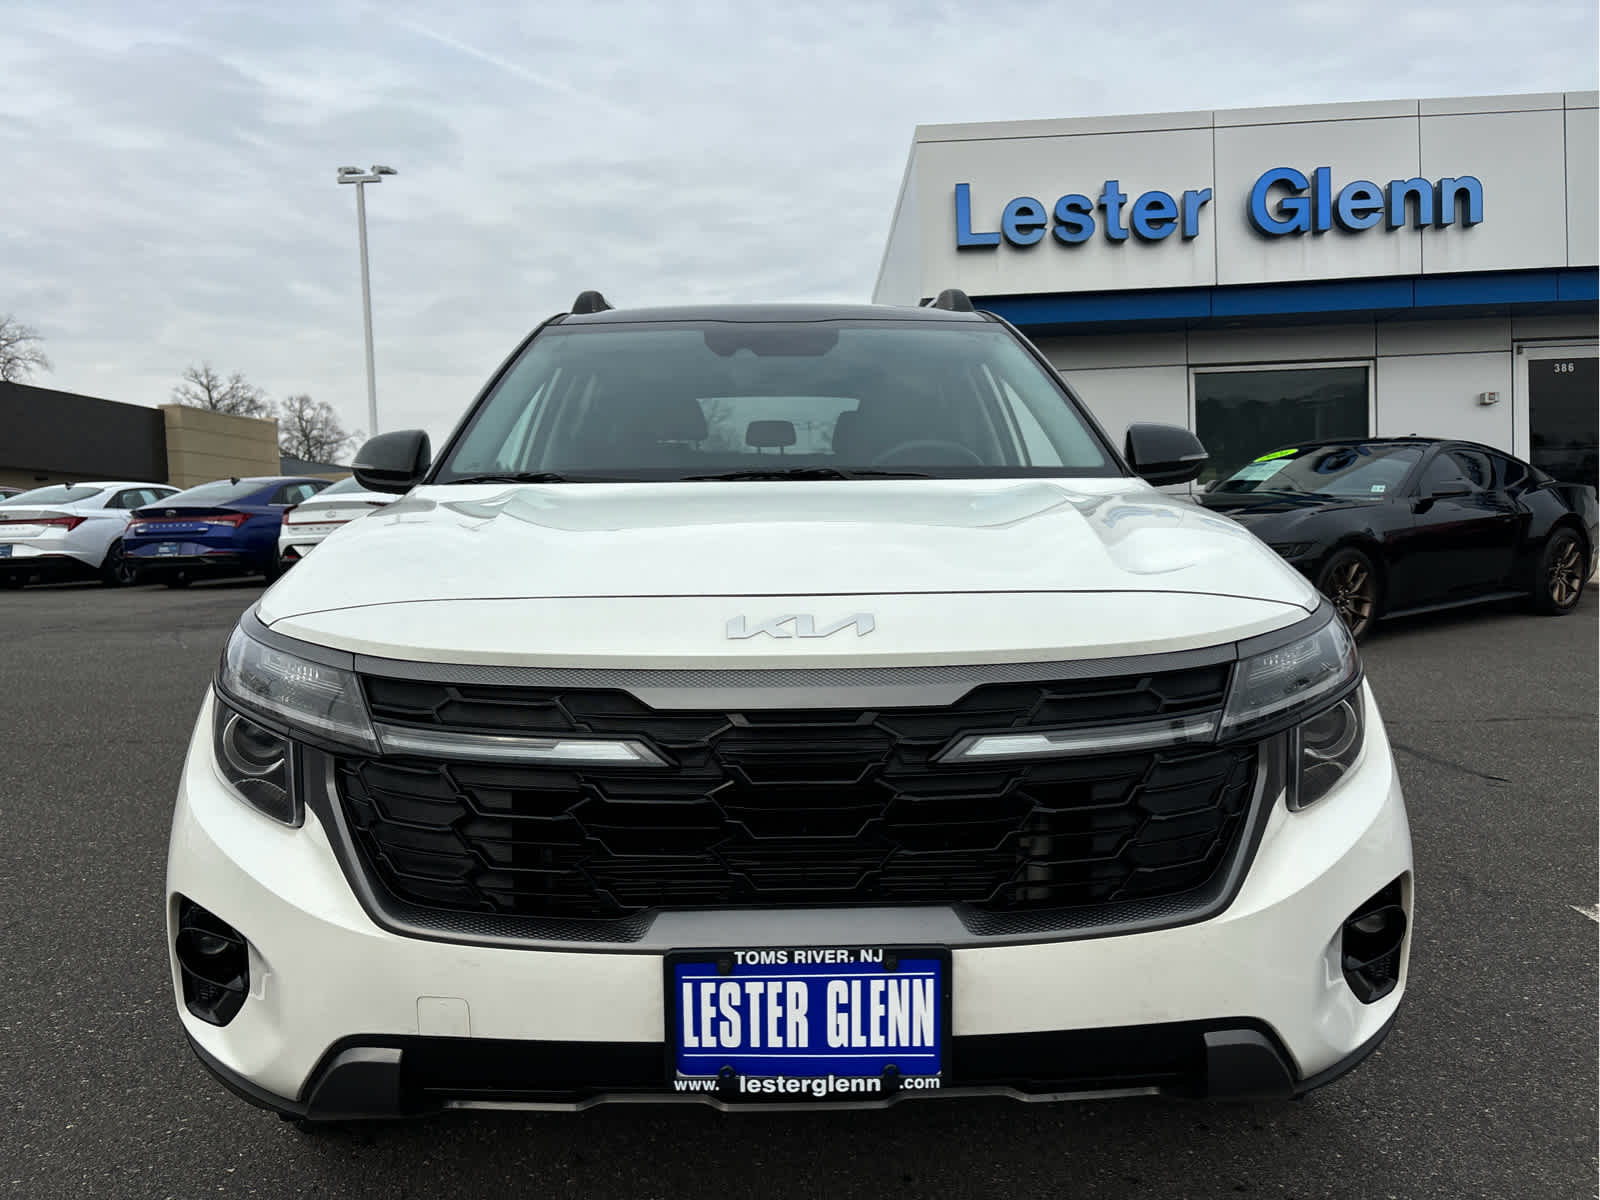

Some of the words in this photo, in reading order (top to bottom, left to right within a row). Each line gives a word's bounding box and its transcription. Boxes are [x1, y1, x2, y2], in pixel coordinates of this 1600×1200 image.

[955, 179, 1212, 250] Lester
[1247, 166, 1484, 237] Glenn
[1553, 362, 1575, 373] 386
[734, 950, 788, 966] TOMS
[794, 949, 855, 964] RIVER,
[860, 949, 884, 963] NJ
[682, 981, 809, 1048] LESTER
[826, 978, 935, 1048] GLENN
[739, 1074, 881, 1097] lesterglenn
